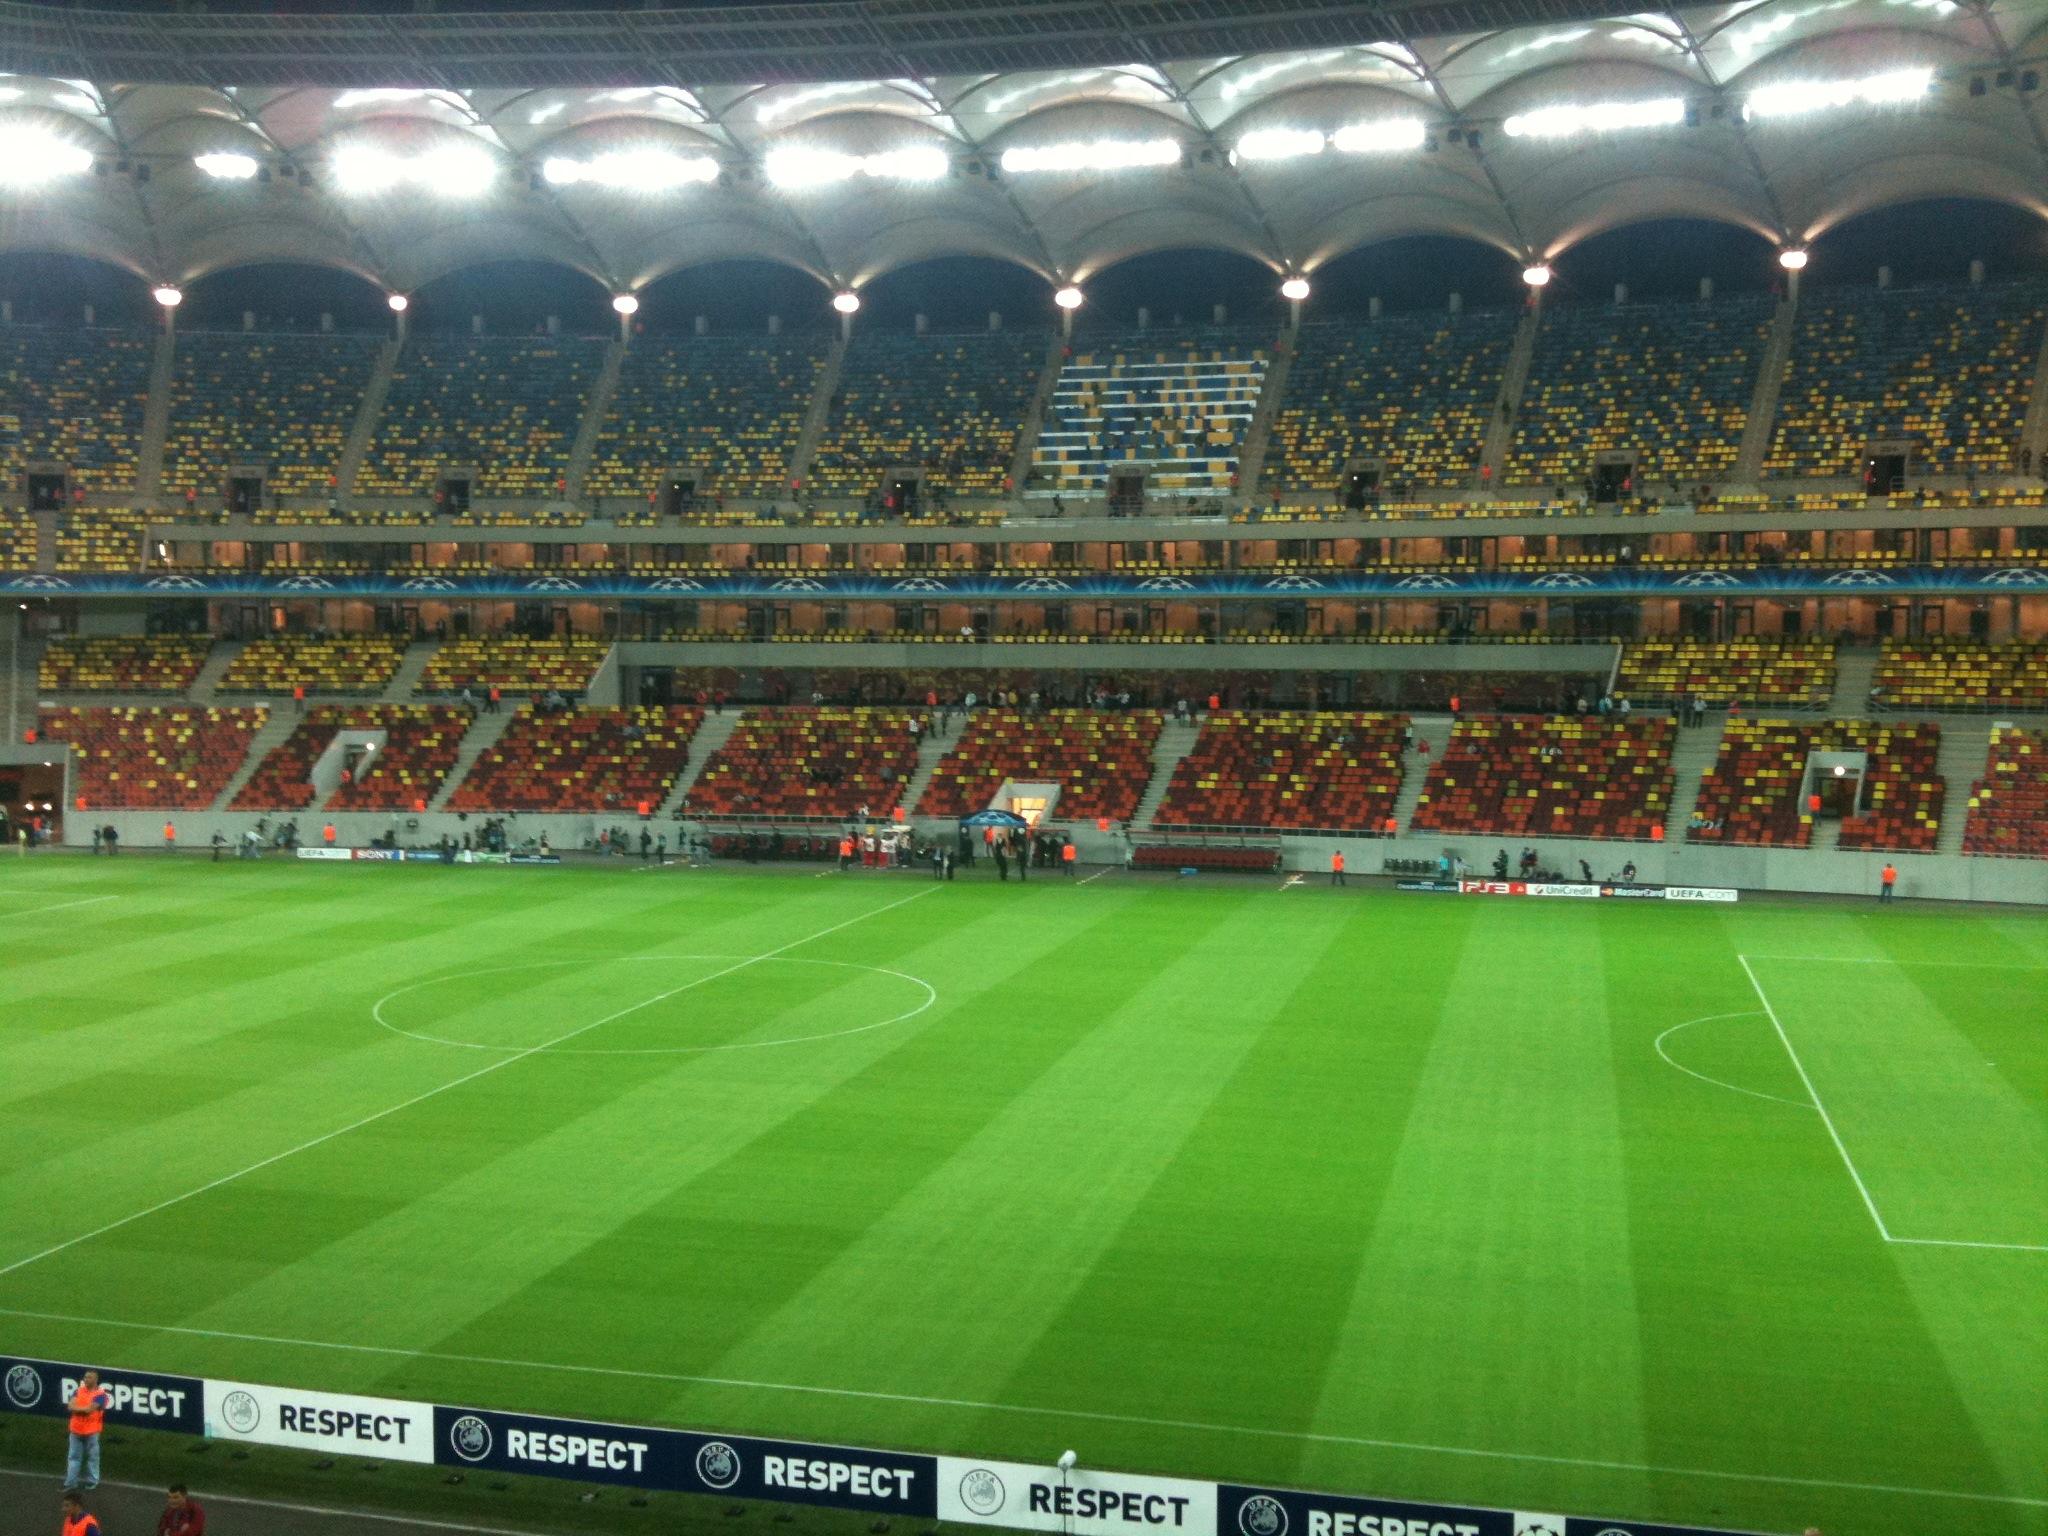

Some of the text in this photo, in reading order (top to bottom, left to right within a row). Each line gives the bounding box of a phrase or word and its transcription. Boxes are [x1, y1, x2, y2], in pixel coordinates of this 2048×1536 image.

[1546, 885, 1593, 895] UniCredit
[61, 1377, 185, 1418] RSPECT
[280, 1405, 410, 1444] RESPECT
[508, 1429, 648, 1472] RESPECT
[764, 1455, 915, 1499] RESPECT
[1030, 1483, 1189, 1526] RESPECT
